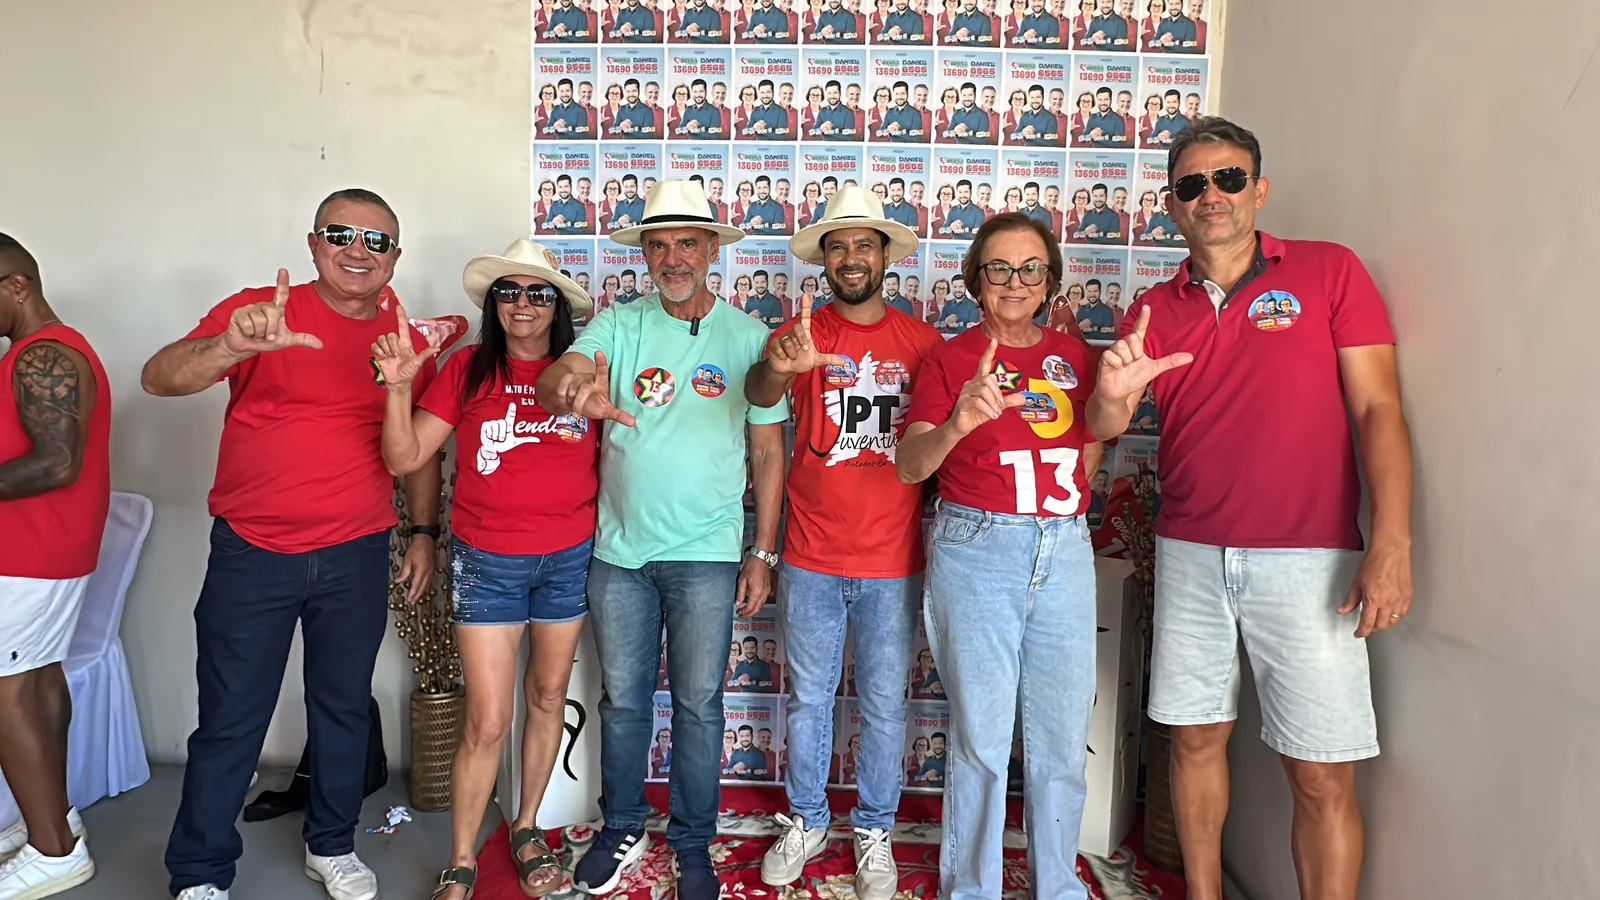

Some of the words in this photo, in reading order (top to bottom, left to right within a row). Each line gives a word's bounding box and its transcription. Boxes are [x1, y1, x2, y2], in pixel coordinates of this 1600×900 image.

[540, 65, 564, 73] 13690
[606, 65, 631, 73] 13690
[673, 65, 698, 74] 13690
[740, 66, 765, 74] 13690
[807, 67, 832, 75] 13690
[875, 67, 900, 76] 13690
[943, 68, 968, 77] 13690
[970, 67, 996, 75] 6565
[1011, 70, 1036, 79] 13690
[1079, 73, 1104, 81] 13690
[1106, 72, 1132, 80] 6565
[1174, 74, 1200, 82] 6565
[1147, 75, 1172, 84] 13690
[539, 161, 563, 169] 13690
[604, 161, 628, 169] 13690
[671, 161, 695, 169] 13690
[737, 162, 762, 170] 13690
[804, 163, 829, 171] 13690
[872, 164, 896, 172] 13690
[939, 165, 964, 174] 13690
[1006, 168, 1031, 176] 13690
[1074, 169, 1099, 178] 13690
[1142, 172, 1166, 180] 13690
[603, 256, 627, 264] 13690
[1069, 265, 1093, 273] 13690
[1136, 268, 1160, 276] 13690
[995, 373, 1008, 383] 13
[650, 381, 662, 393] 13
[846, 396, 900, 433] PT
[999, 447, 1082, 516] 13
